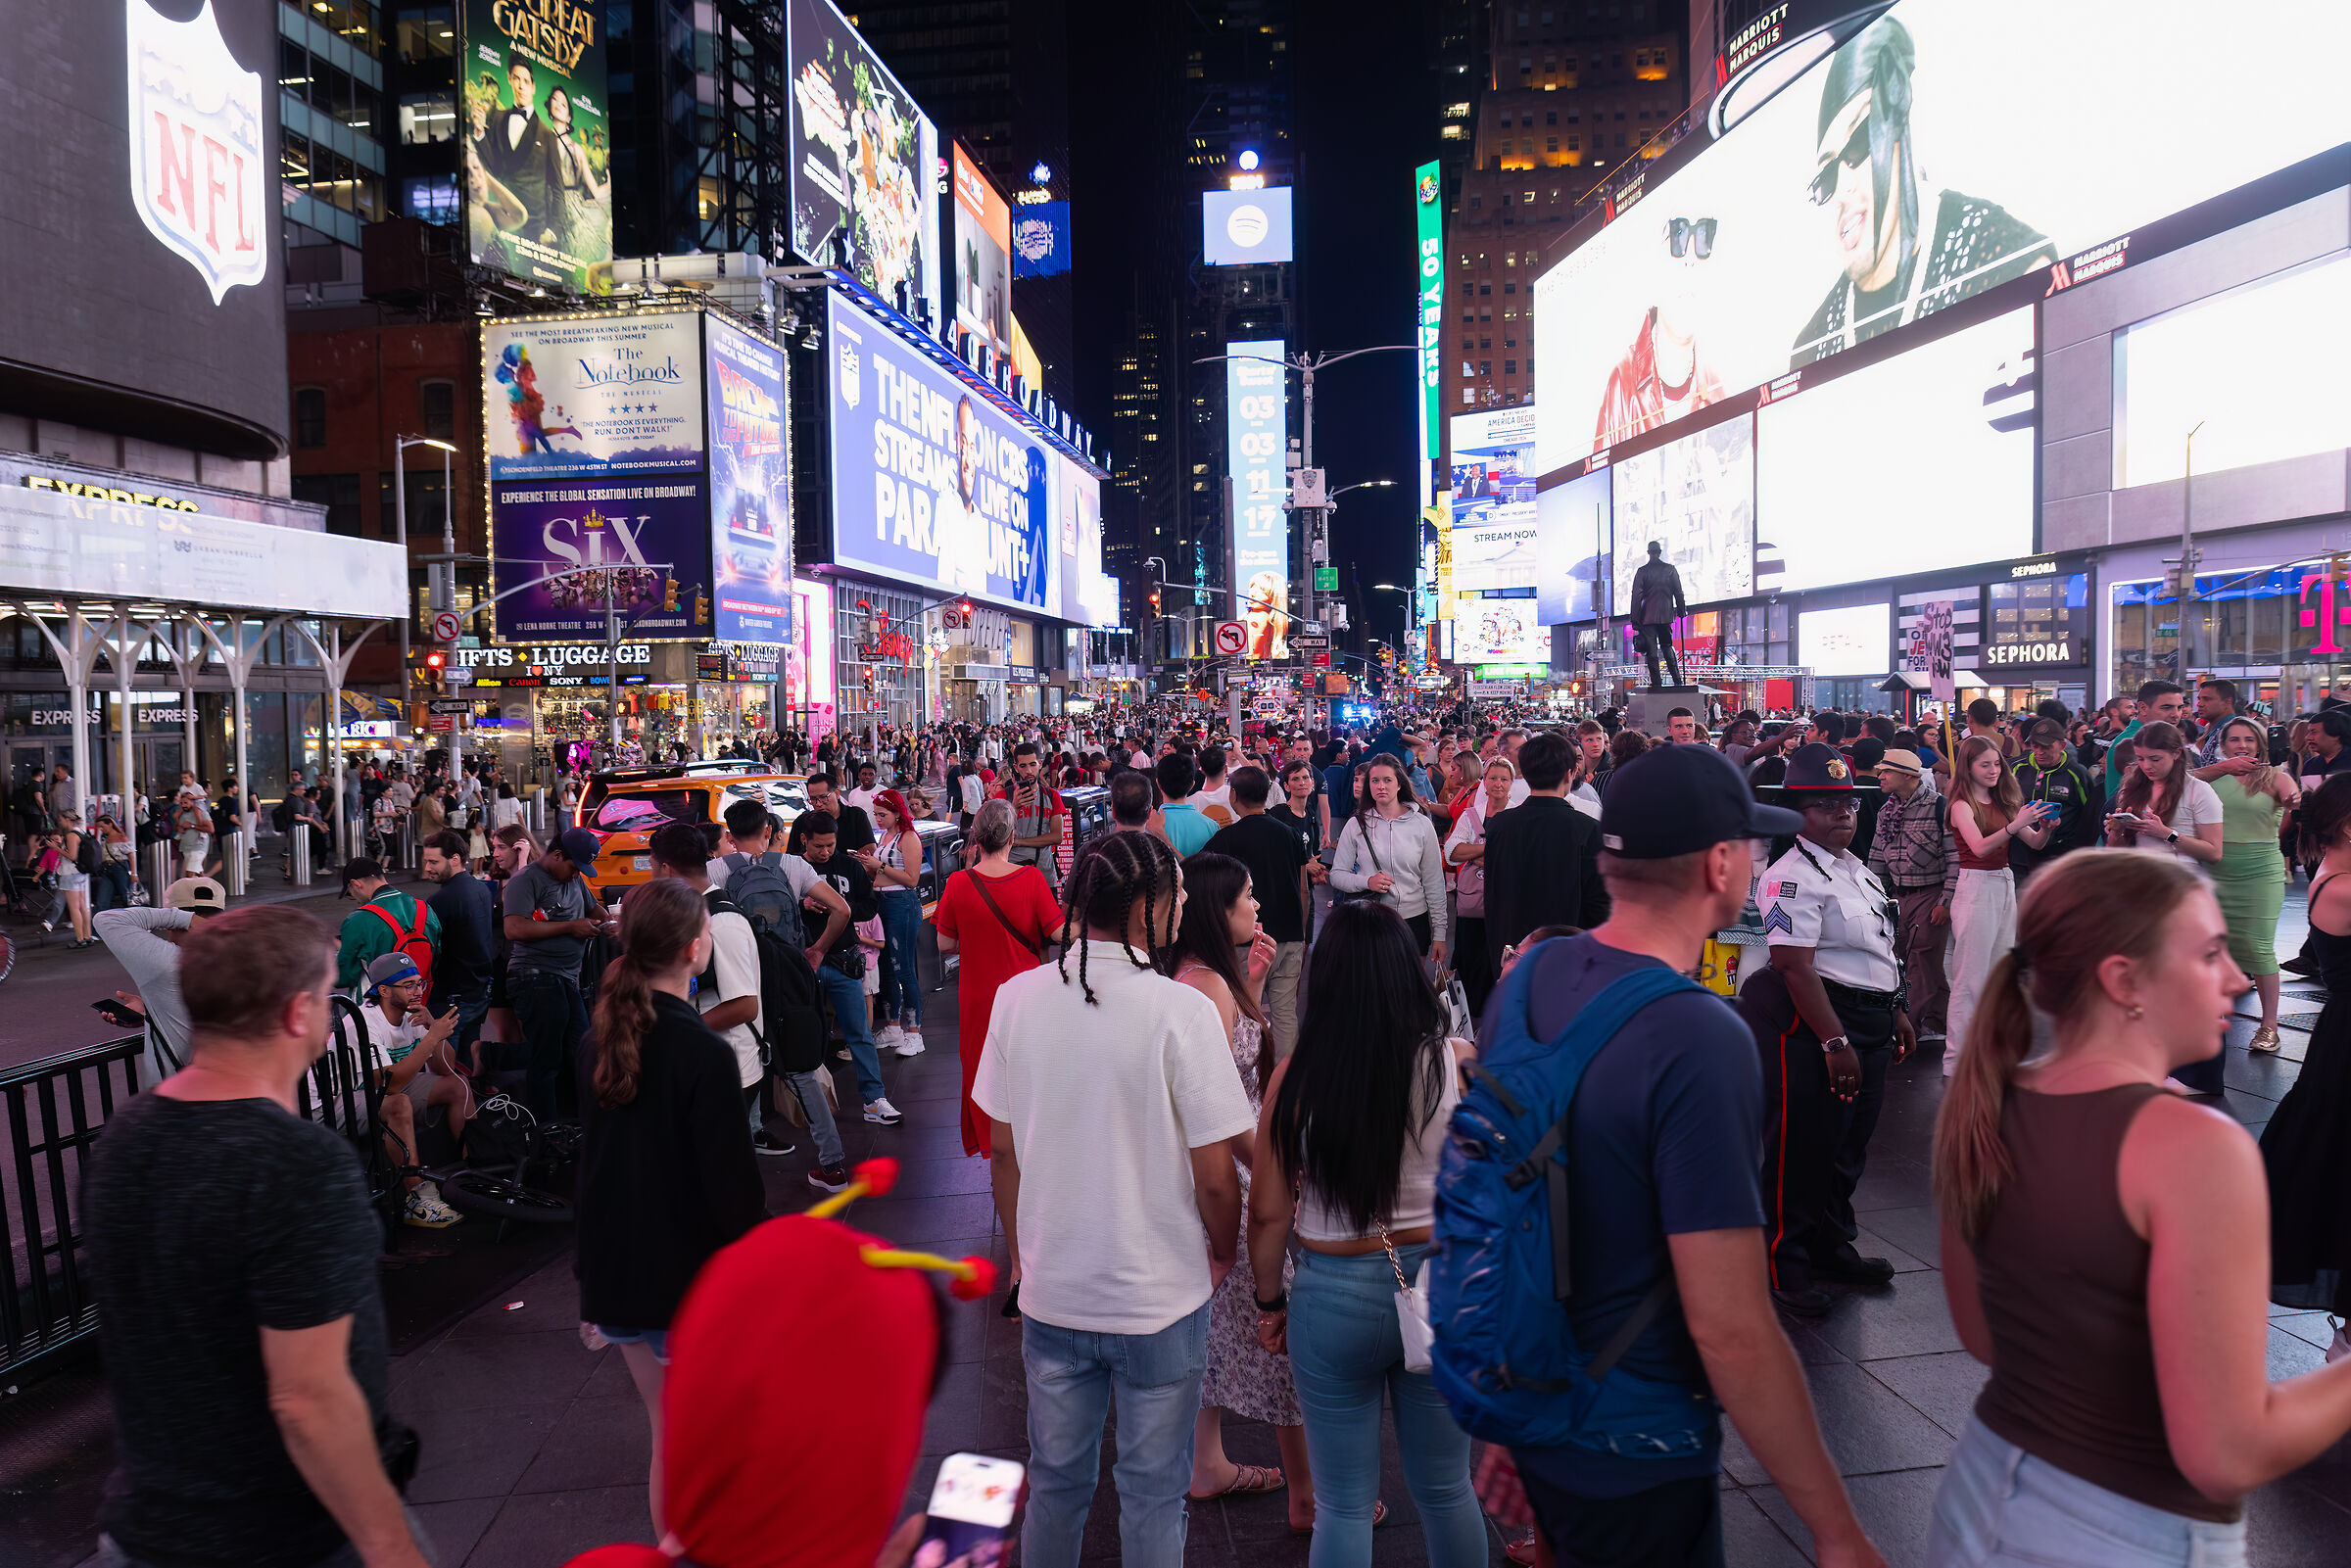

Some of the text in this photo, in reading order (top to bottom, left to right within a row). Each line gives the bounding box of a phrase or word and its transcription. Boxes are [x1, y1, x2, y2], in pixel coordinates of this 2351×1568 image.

[493, 0, 586, 70] GATSBY
[1730, 3, 1789, 57] MARRIOTT
[509, 40, 517, 52] A
[516, 43, 538, 62] NEW
[537, 54, 572, 79] MUSICAL
[1730, 27, 1780, 73] MARQUIS
[154, 110, 255, 256] NFL
[2074, 236, 2131, 268] MARRIOTT
[2074, 254, 2124, 283] MARQUIS
[1421, 237, 1443, 388] 50 YEARS
[541, 329, 561, 338] MOST
[563, 326, 620, 336] BREATHTAKING
[621, 324, 640, 333] NEW
[642, 322, 675, 332] MUSICAL
[552, 335, 596, 345] BROADWAY
[598, 334, 612, 343] THIS
[615, 332, 647, 342] SUMMER
[613, 348, 644, 360] The
[576, 356, 682, 385] Notebook
[715, 357, 772, 418] BACK
[984, 344, 1093, 458] BROADWAY
[1239, 395, 1275, 420] 03
[596, 418, 634, 428] NOTEBOOK
[723, 406, 781, 443] TO FUTURE
[874, 353, 923, 428] THE
[974, 418, 998, 470] ON
[999, 433, 1030, 493] CBS
[1488, 416, 1515, 427] AMERICA
[1240, 432, 1276, 456] 03
[611, 458, 696, 470] NOTEBOOKMUSICAL.COM
[874, 419, 1030, 533] STREAMS LIVE ON
[502, 485, 696, 503] EXPERIENCE THE GLOBAL SENSATION LIVE ON BROADWAY!
[542, 515, 651, 580] SIX
[1474, 531, 1512, 543] STREAM
[2011, 561, 2057, 578] SEPHORA
[457, 644, 650, 667] IFTS LUGGAGE
[742, 645, 780, 663] LUGGAGE
[1987, 642, 2070, 664] SEPHORA
[526, 665, 565, 676] I NY
[752, 673, 767, 682] SONY
[508, 677, 541, 687] Canon
[550, 677, 584, 686] SONY
[31, 710, 102, 726] EXPRSS
[811, 718, 835, 727] BLIND
[813, 726, 833, 735] BOX
[1016, 805, 1032, 820] EW
